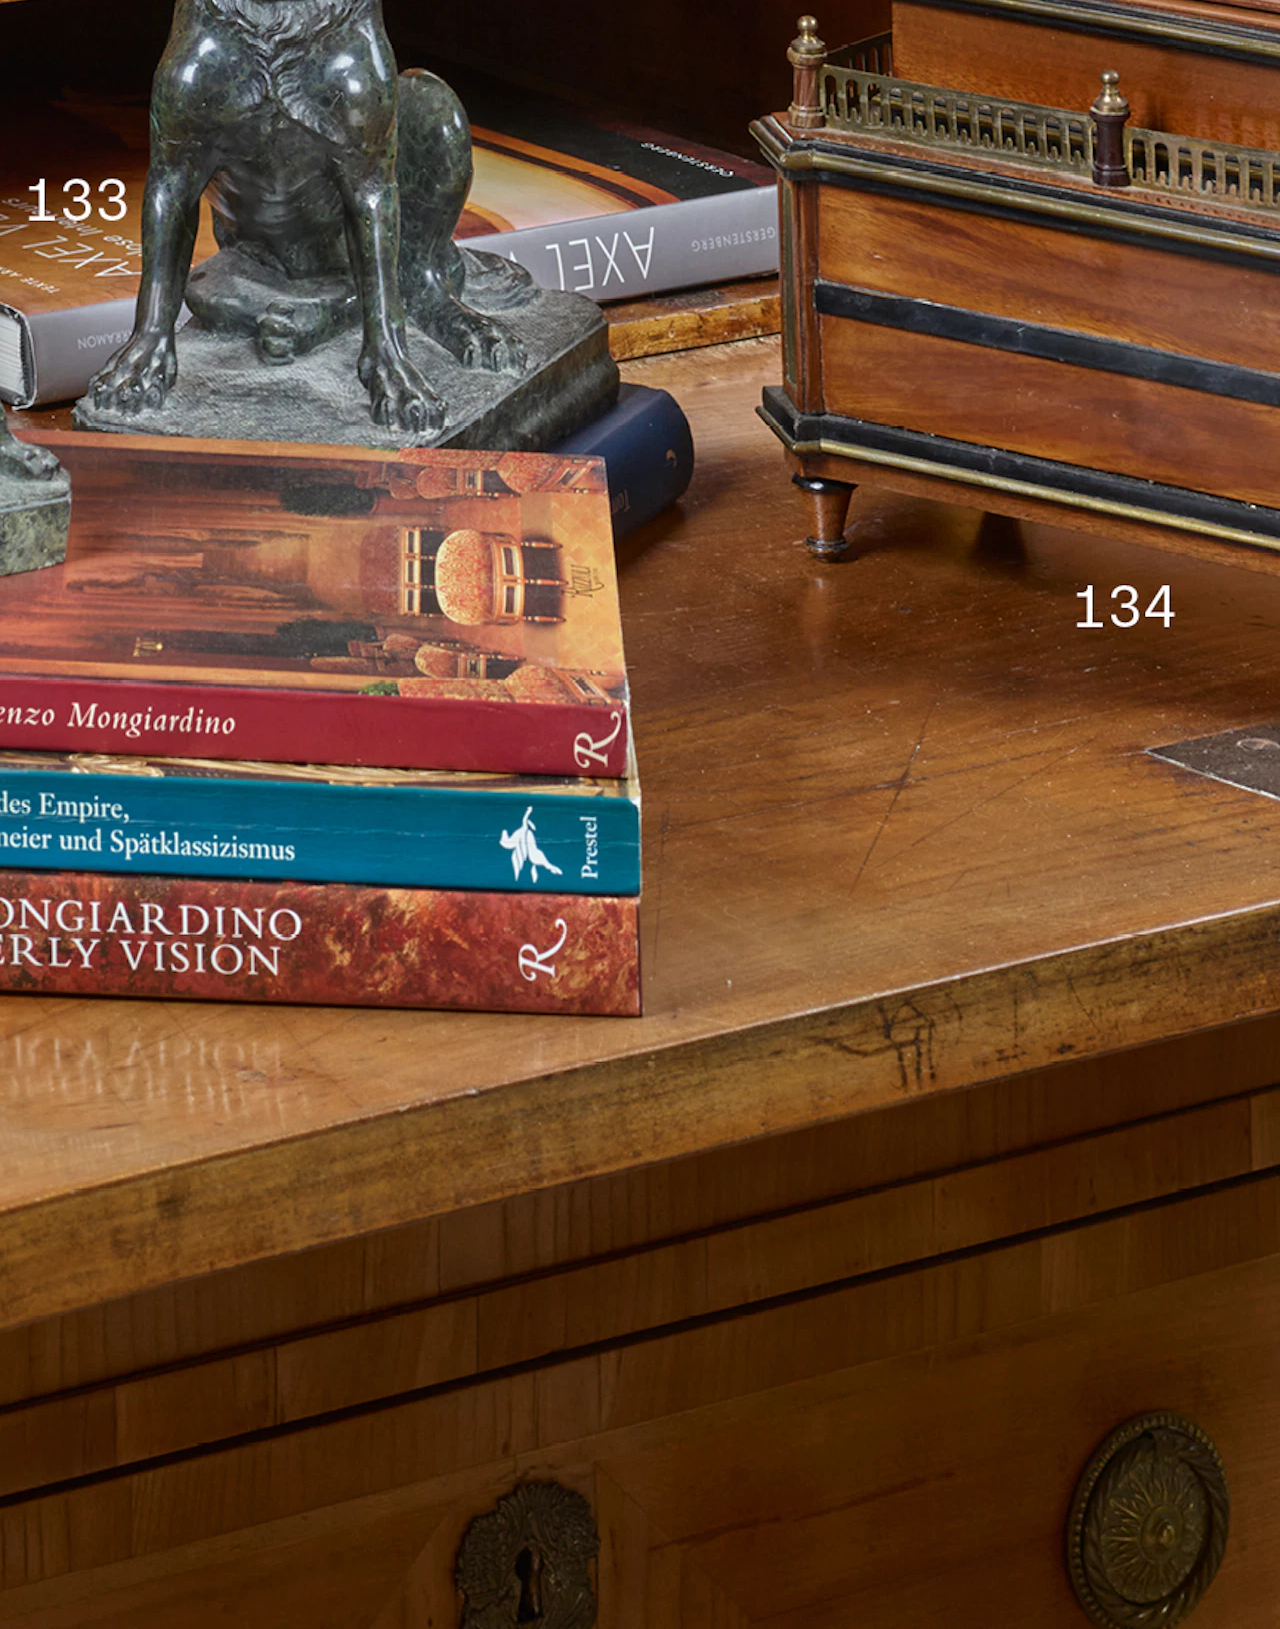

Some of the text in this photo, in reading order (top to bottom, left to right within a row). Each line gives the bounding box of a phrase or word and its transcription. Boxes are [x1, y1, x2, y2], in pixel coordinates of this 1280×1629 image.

[558, 225, 657, 294] AXEL
[690, 225, 777, 254] GERSTENBERG
[67, 702, 238, 747] Mongiardino
[38, 796, 130, 834] Empire,
[58, 827, 100, 855] und
[109, 831, 296, 868] Spätklassizismus
[580, 815, 599, 879] Prestel
[121, 937, 282, 977] VISION
